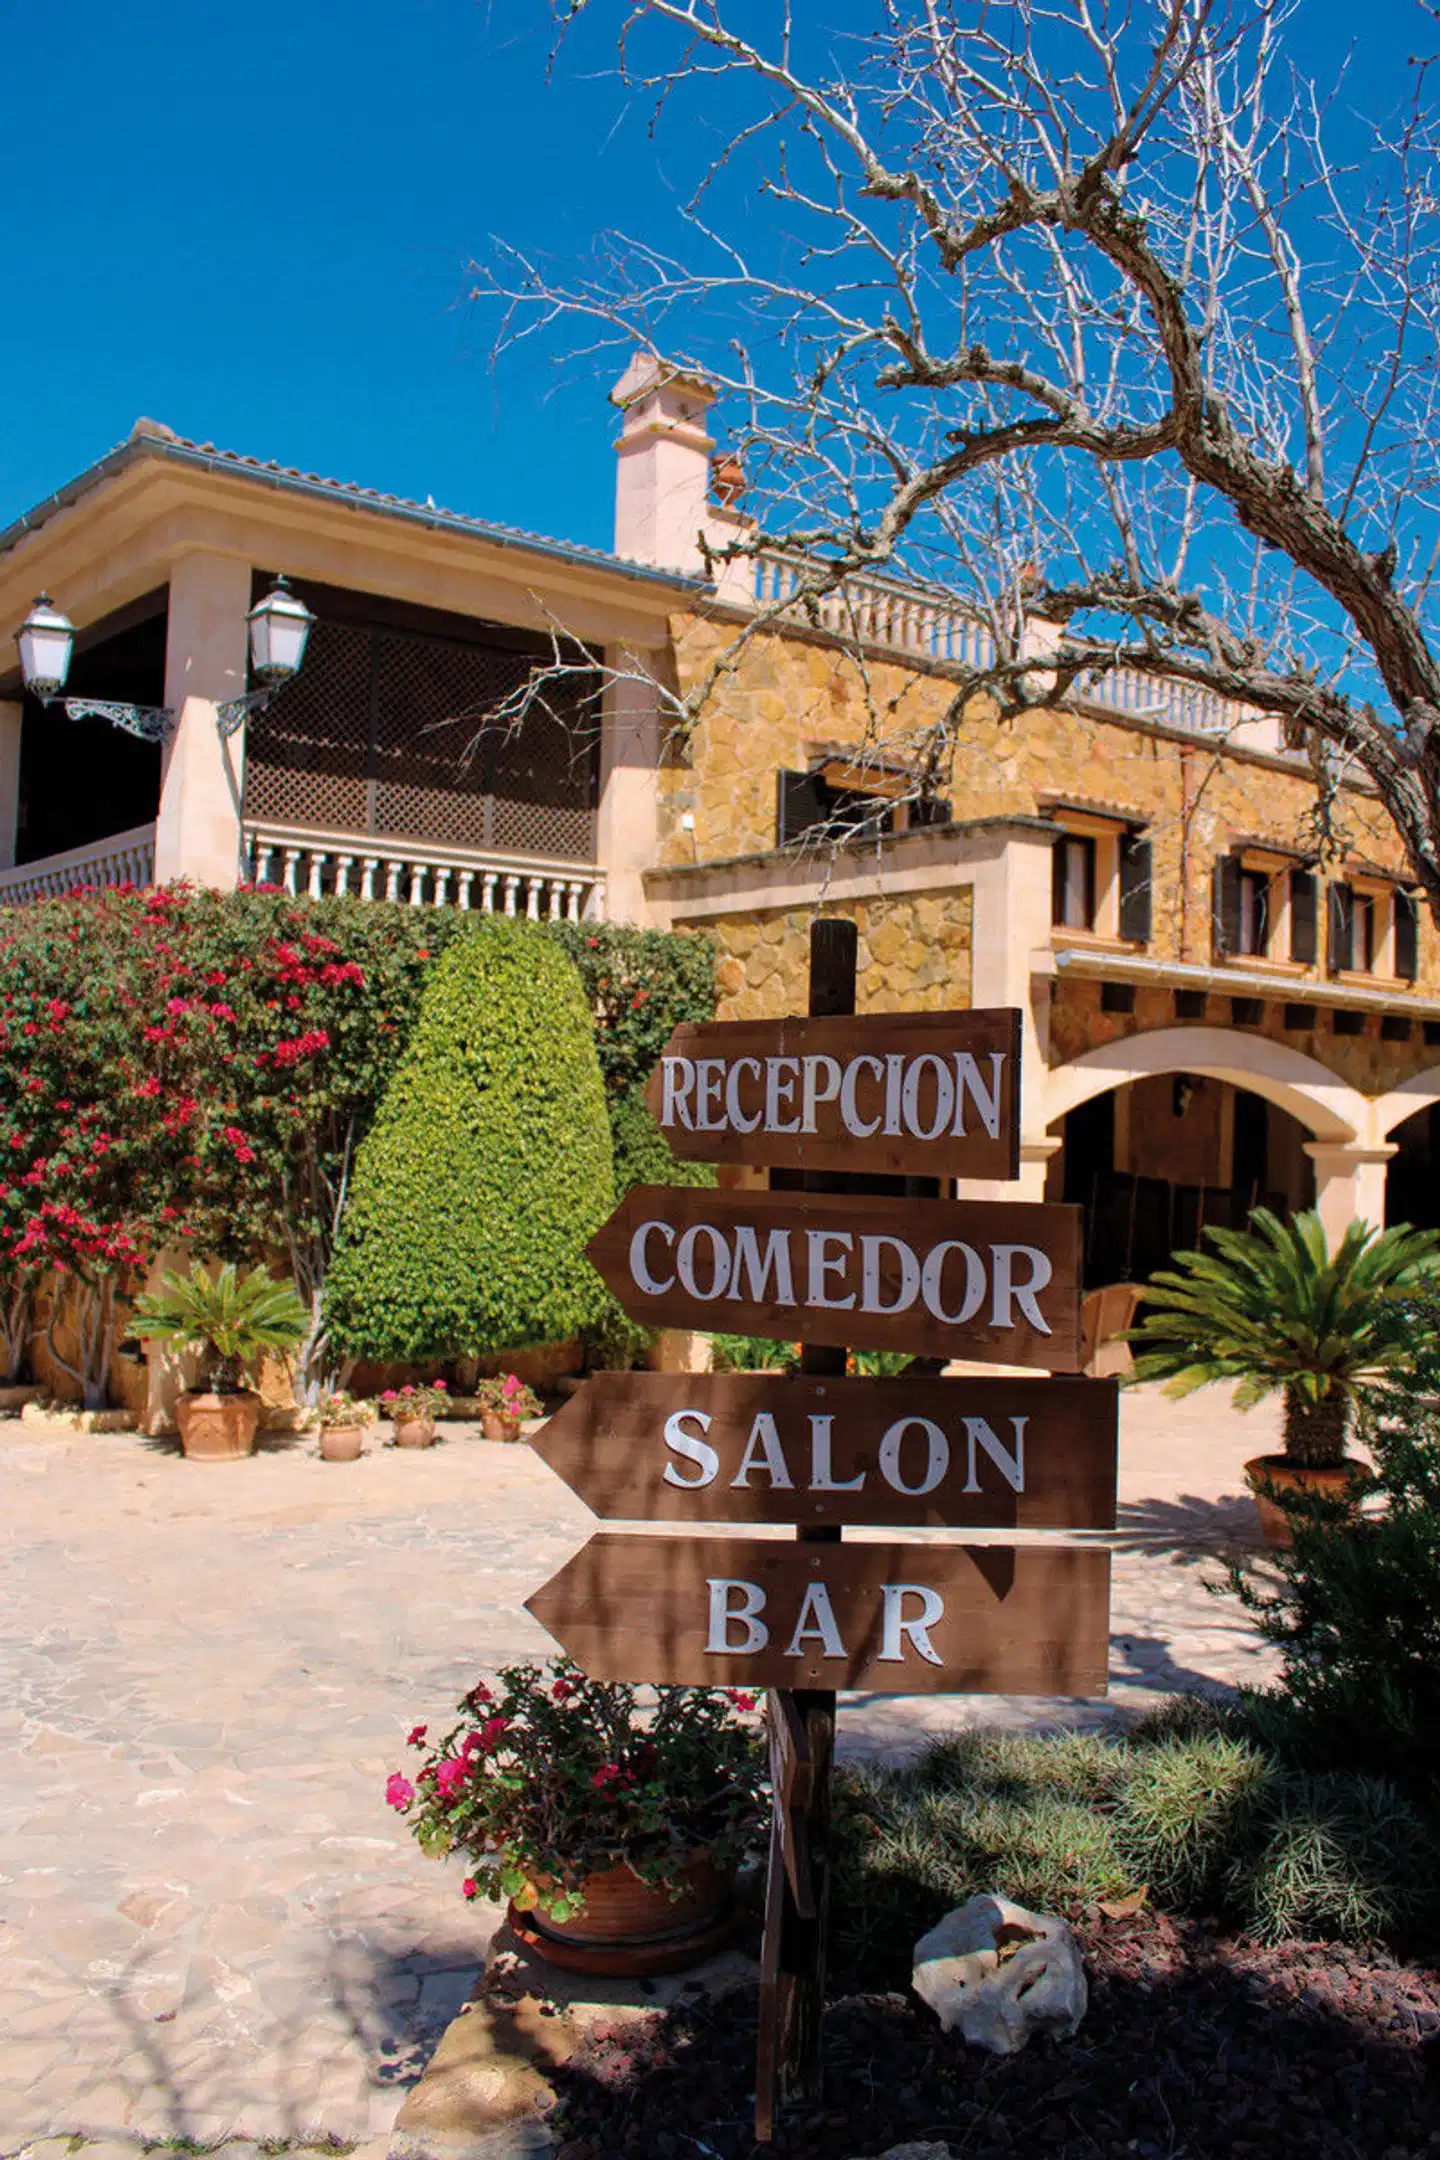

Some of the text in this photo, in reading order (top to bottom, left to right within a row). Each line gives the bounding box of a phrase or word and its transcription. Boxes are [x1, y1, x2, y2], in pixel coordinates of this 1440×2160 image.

[660, 1052, 1006, 1140] RECEPCION
[628, 1220, 1053, 1336] COMEDOR
[662, 1409, 1029, 1494] SALON
[704, 1578, 945, 1668] BAR
